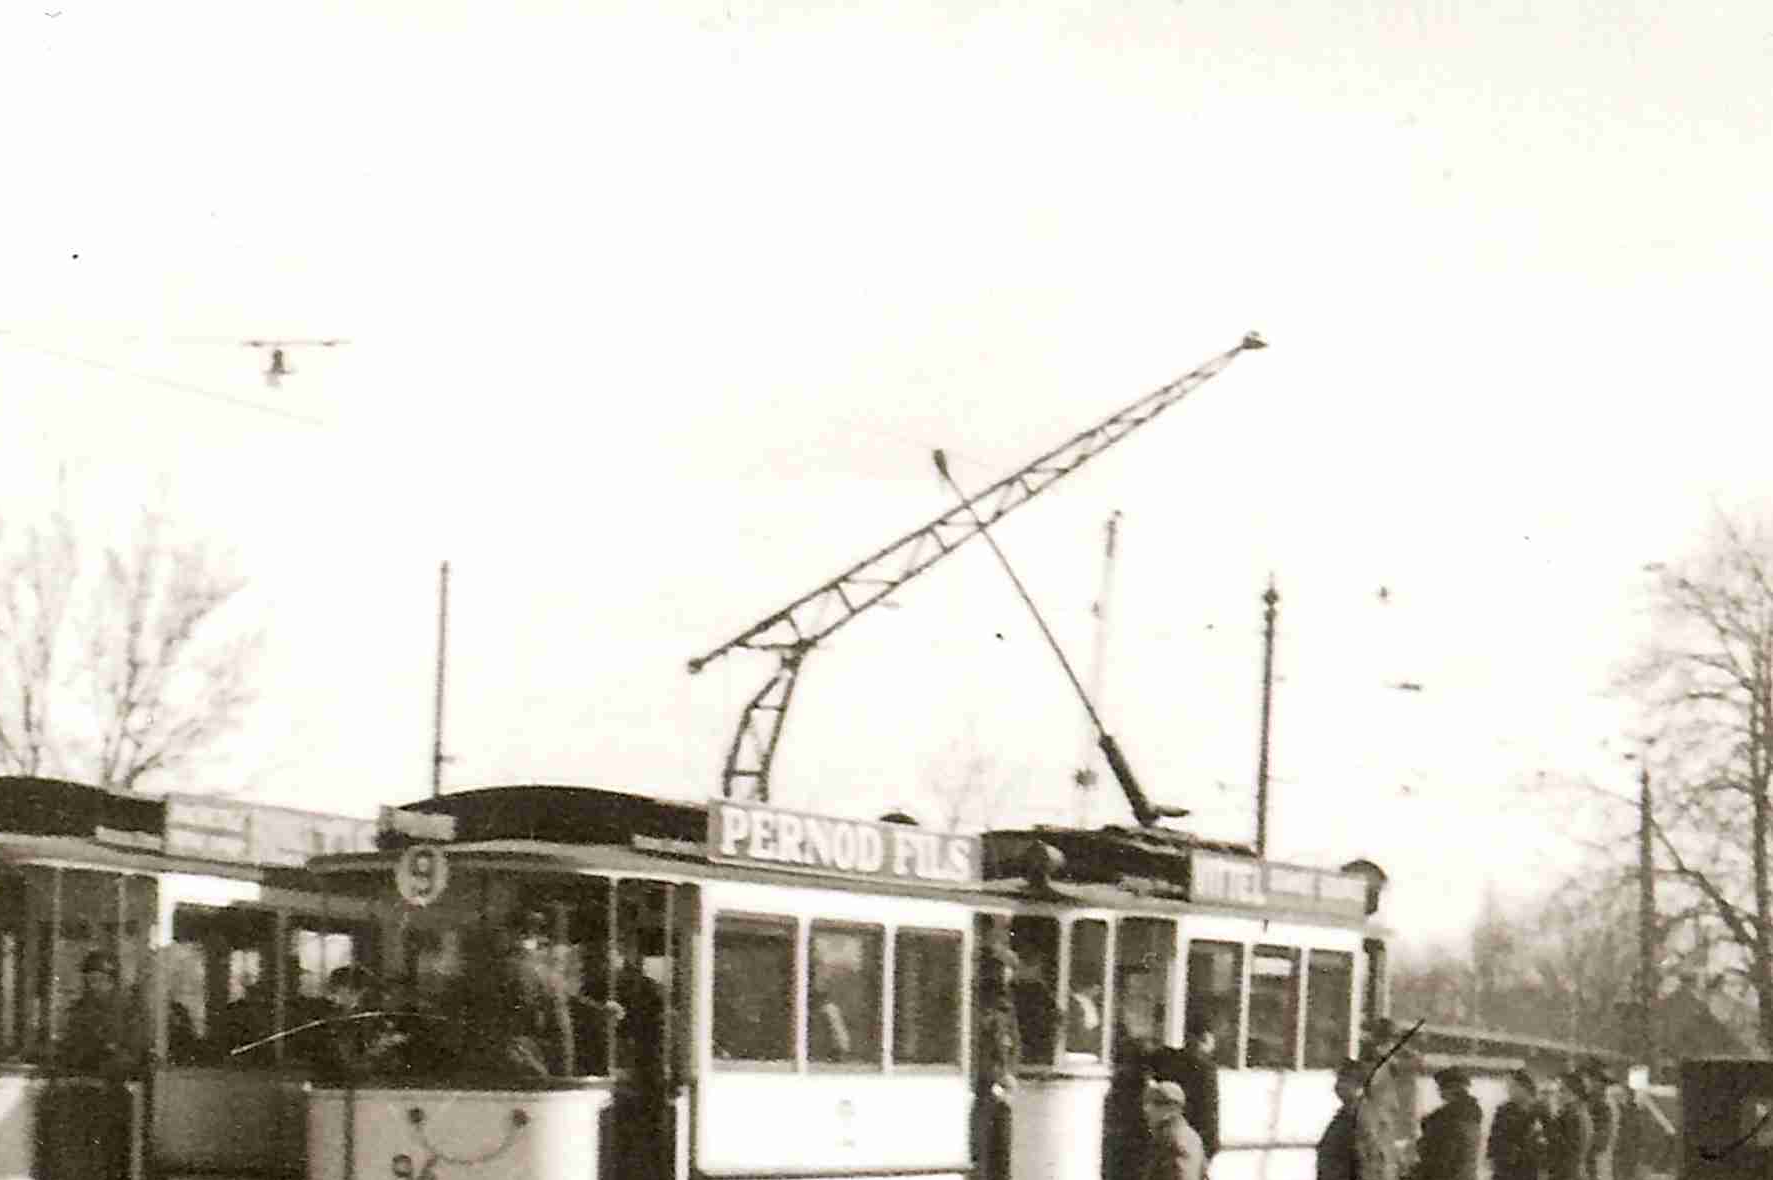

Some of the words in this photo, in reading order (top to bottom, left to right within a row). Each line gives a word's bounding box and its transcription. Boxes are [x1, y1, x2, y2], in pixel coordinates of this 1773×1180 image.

[409, 848, 435, 898] 9
[720, 807, 883, 873] PERNOD
[892, 830, 972, 882] FILS
